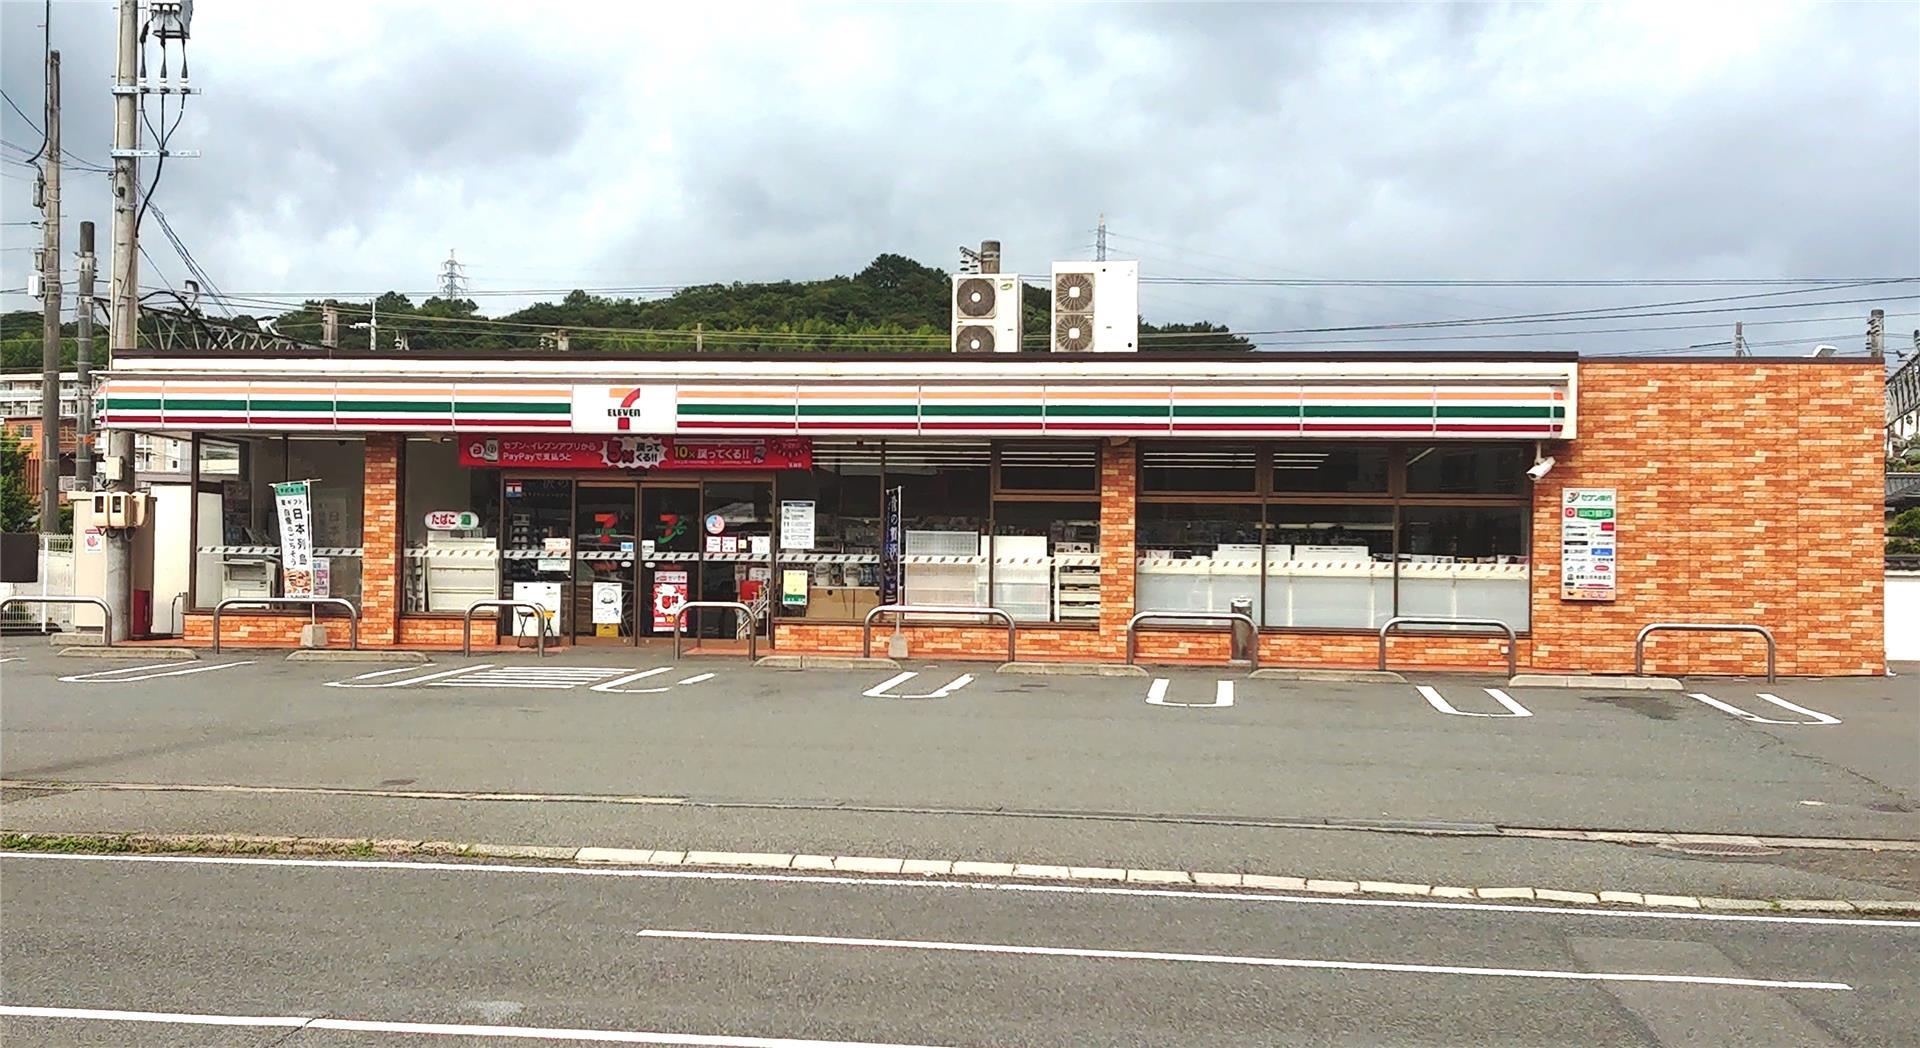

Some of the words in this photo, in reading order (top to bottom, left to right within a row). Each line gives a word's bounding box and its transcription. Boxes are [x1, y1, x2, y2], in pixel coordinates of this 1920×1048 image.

[609, 388, 640, 430] 7
[293, 508, 307, 565] 日本列島
[431, 513, 456, 525] たばこ
